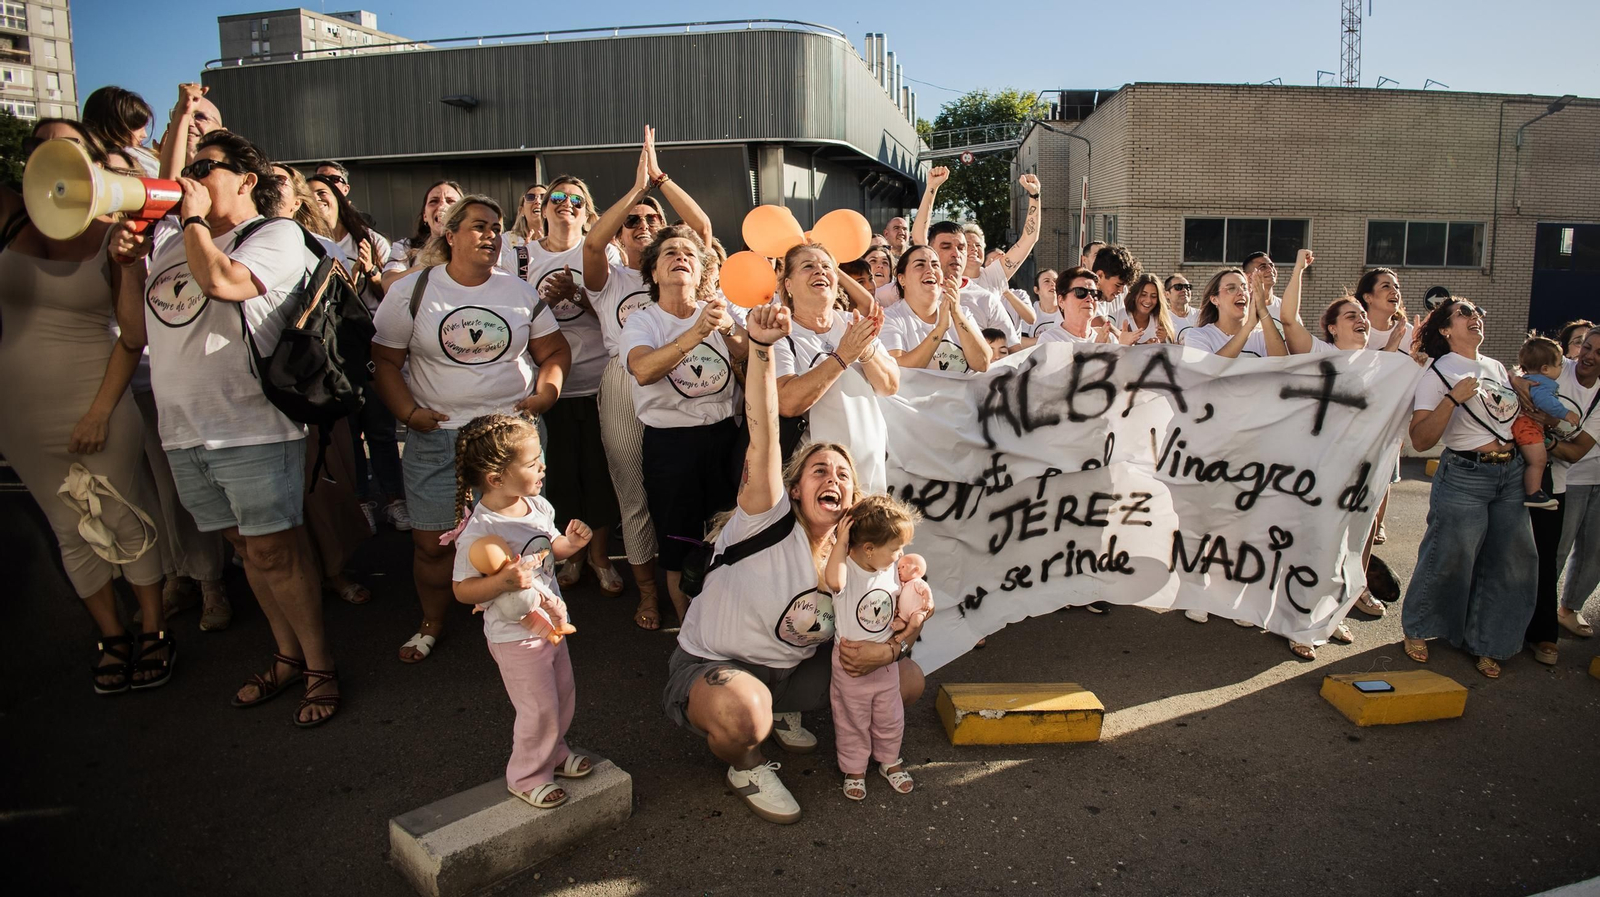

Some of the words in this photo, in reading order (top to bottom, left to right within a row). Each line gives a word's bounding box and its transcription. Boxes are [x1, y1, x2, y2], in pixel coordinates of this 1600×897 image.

[176, 301, 185, 312] de
[444, 340, 470, 354] vinagre
[472, 346, 482, 354] de
[674, 377, 698, 389] vinagre
[700, 380, 709, 388] de
[710, 368, 727, 384] Jerez
[1150, 427, 1322, 511] Vinagre
[1338, 462, 1373, 513] de
[988, 491, 1154, 556] JEREZ
[1040, 534, 1136, 584] rinde
